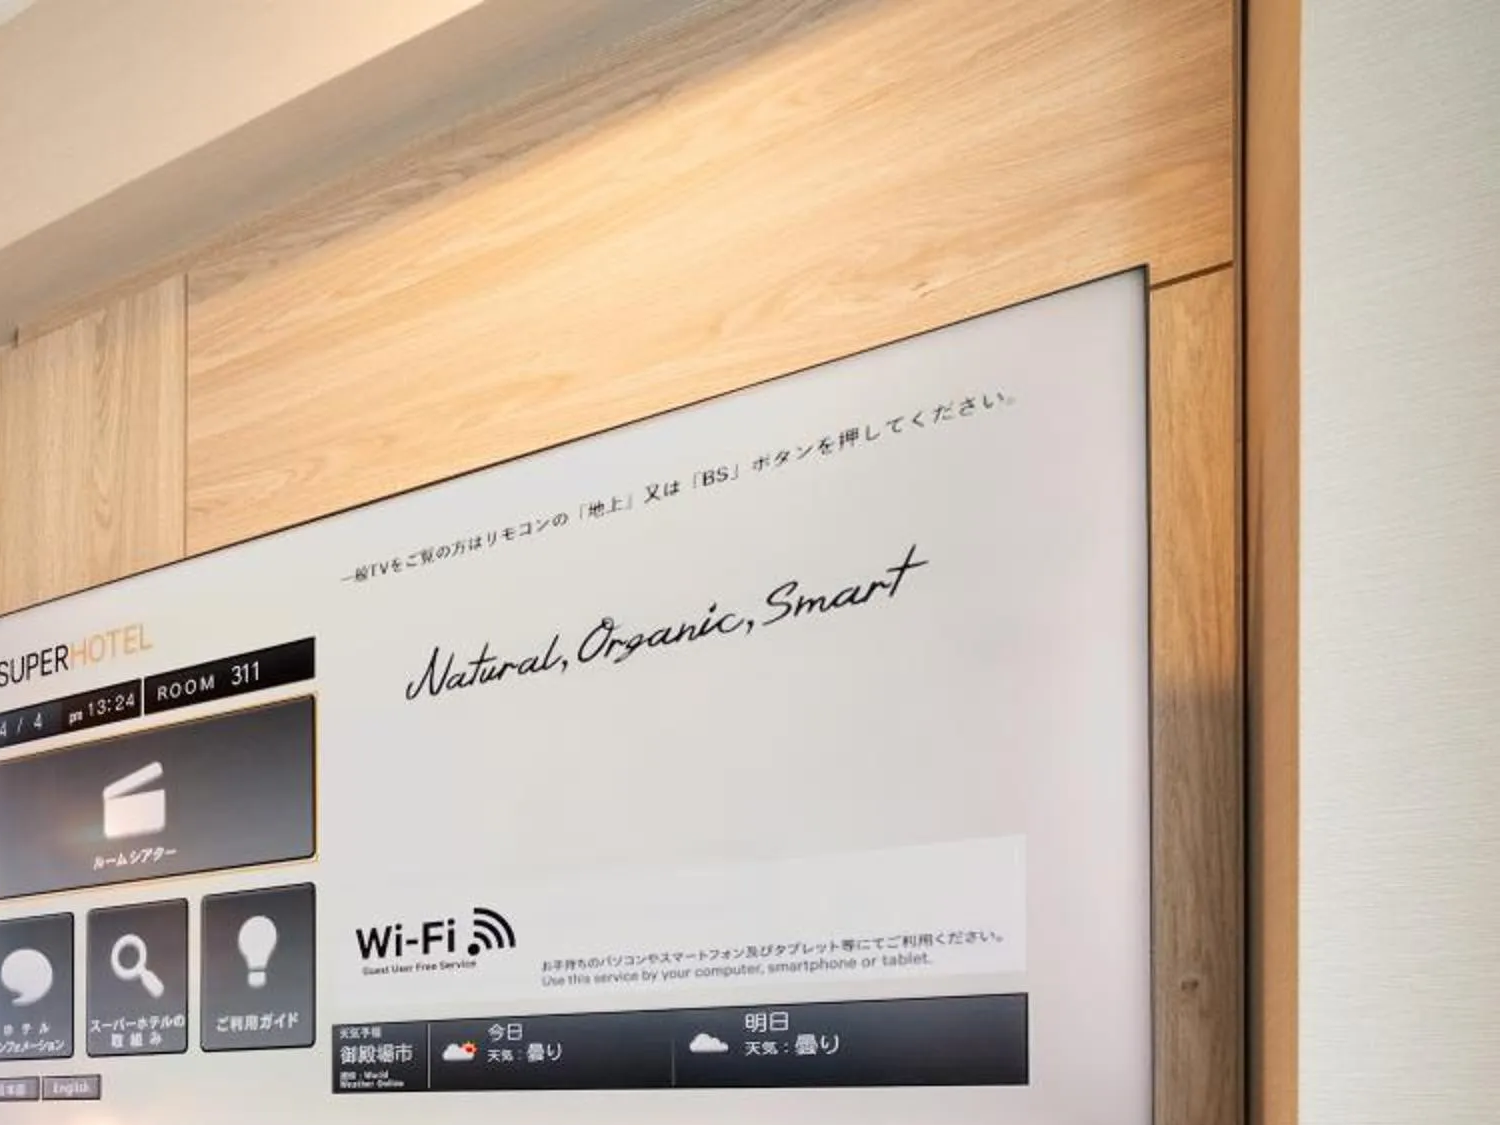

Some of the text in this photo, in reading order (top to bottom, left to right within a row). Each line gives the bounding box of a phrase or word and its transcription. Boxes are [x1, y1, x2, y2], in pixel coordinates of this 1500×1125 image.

[405, 544, 929, 700] Natural, Organic, Smart
[156, 660, 260, 702] ROOM 311
[88, 692, 136, 717] 13:24
[93, 845, 178, 870] ルームシアター
[356, 918, 455, 960] Wi-Fi
[415, 961, 438, 972] Free
[439, 959, 477, 970] Service
[542, 975, 565, 987] Use
[568, 972, 591, 985] this
[594, 970, 639, 984] service
[642, 969, 658, 984] by
[660, 968, 691, 982] your
[694, 963, 766, 979] computer,
[767, 958, 857, 974] smartphone
[861, 957, 876, 969] or
[215, 1011, 300, 1034] ご利用ガイド
[487, 1023, 523, 1042] 今日
[744, 1011, 789, 1033] 明日
[340, 1043, 414, 1065] 御殿場市
[53, 1081, 91, 1098] English
